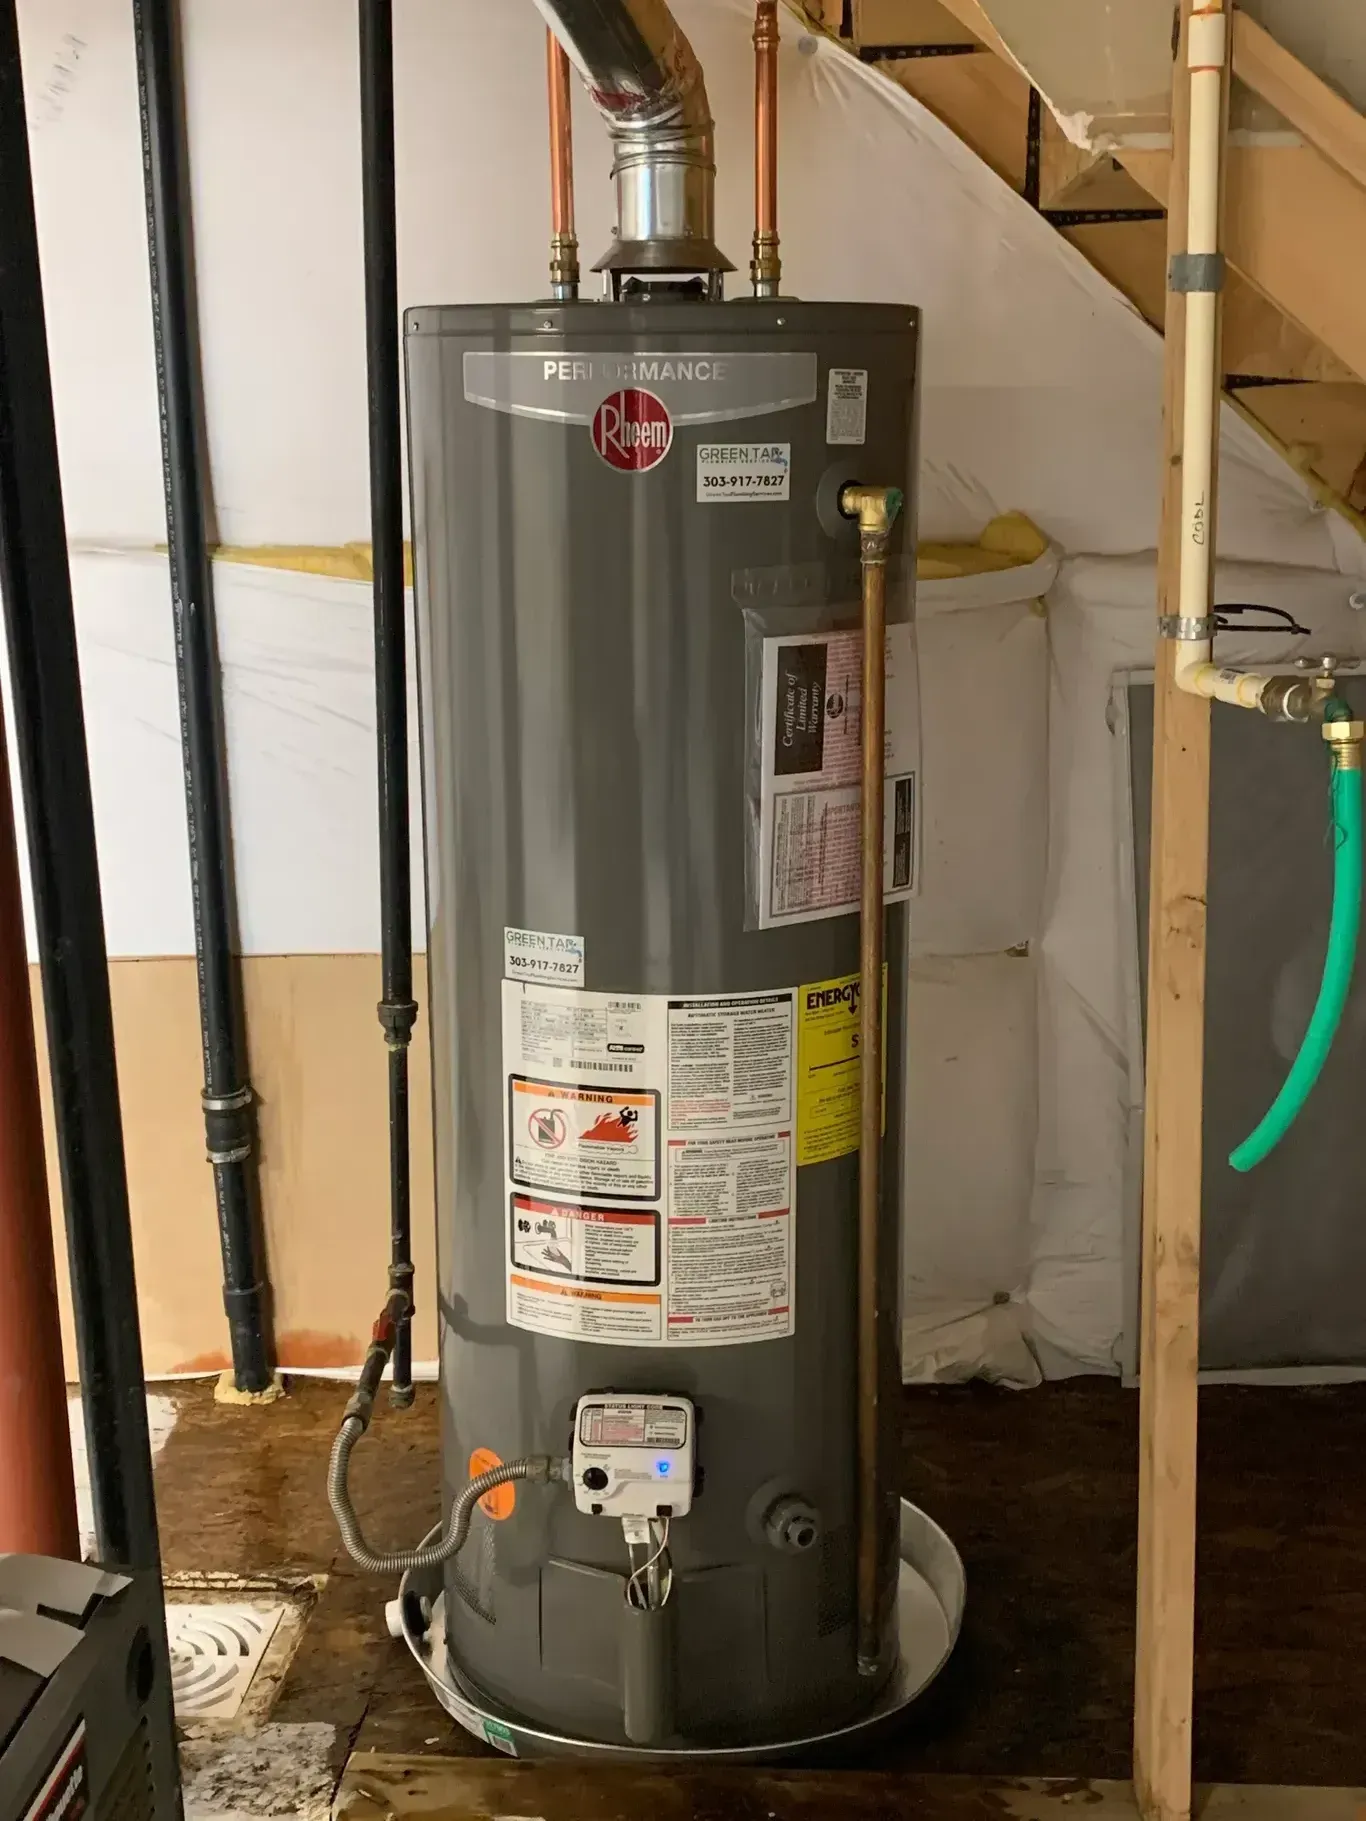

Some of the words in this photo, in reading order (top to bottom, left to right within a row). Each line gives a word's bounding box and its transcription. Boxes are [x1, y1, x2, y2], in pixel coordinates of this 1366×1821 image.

[601, 391, 667, 459] Rheem
[699, 447, 749, 461] GREEN
[703, 475, 785, 488] 303-917-7827
[785, 670, 798, 686] of
[796, 687, 808, 731] Limited
[808, 681, 822, 734] Warranty
[782, 687, 795, 747] Certificate
[506, 931, 545, 946] GREEN
[509, 955, 579, 974] 303-917-7827
[560, 1091, 614, 1104] WARNING
[561, 1210, 605, 1221] DANGER
